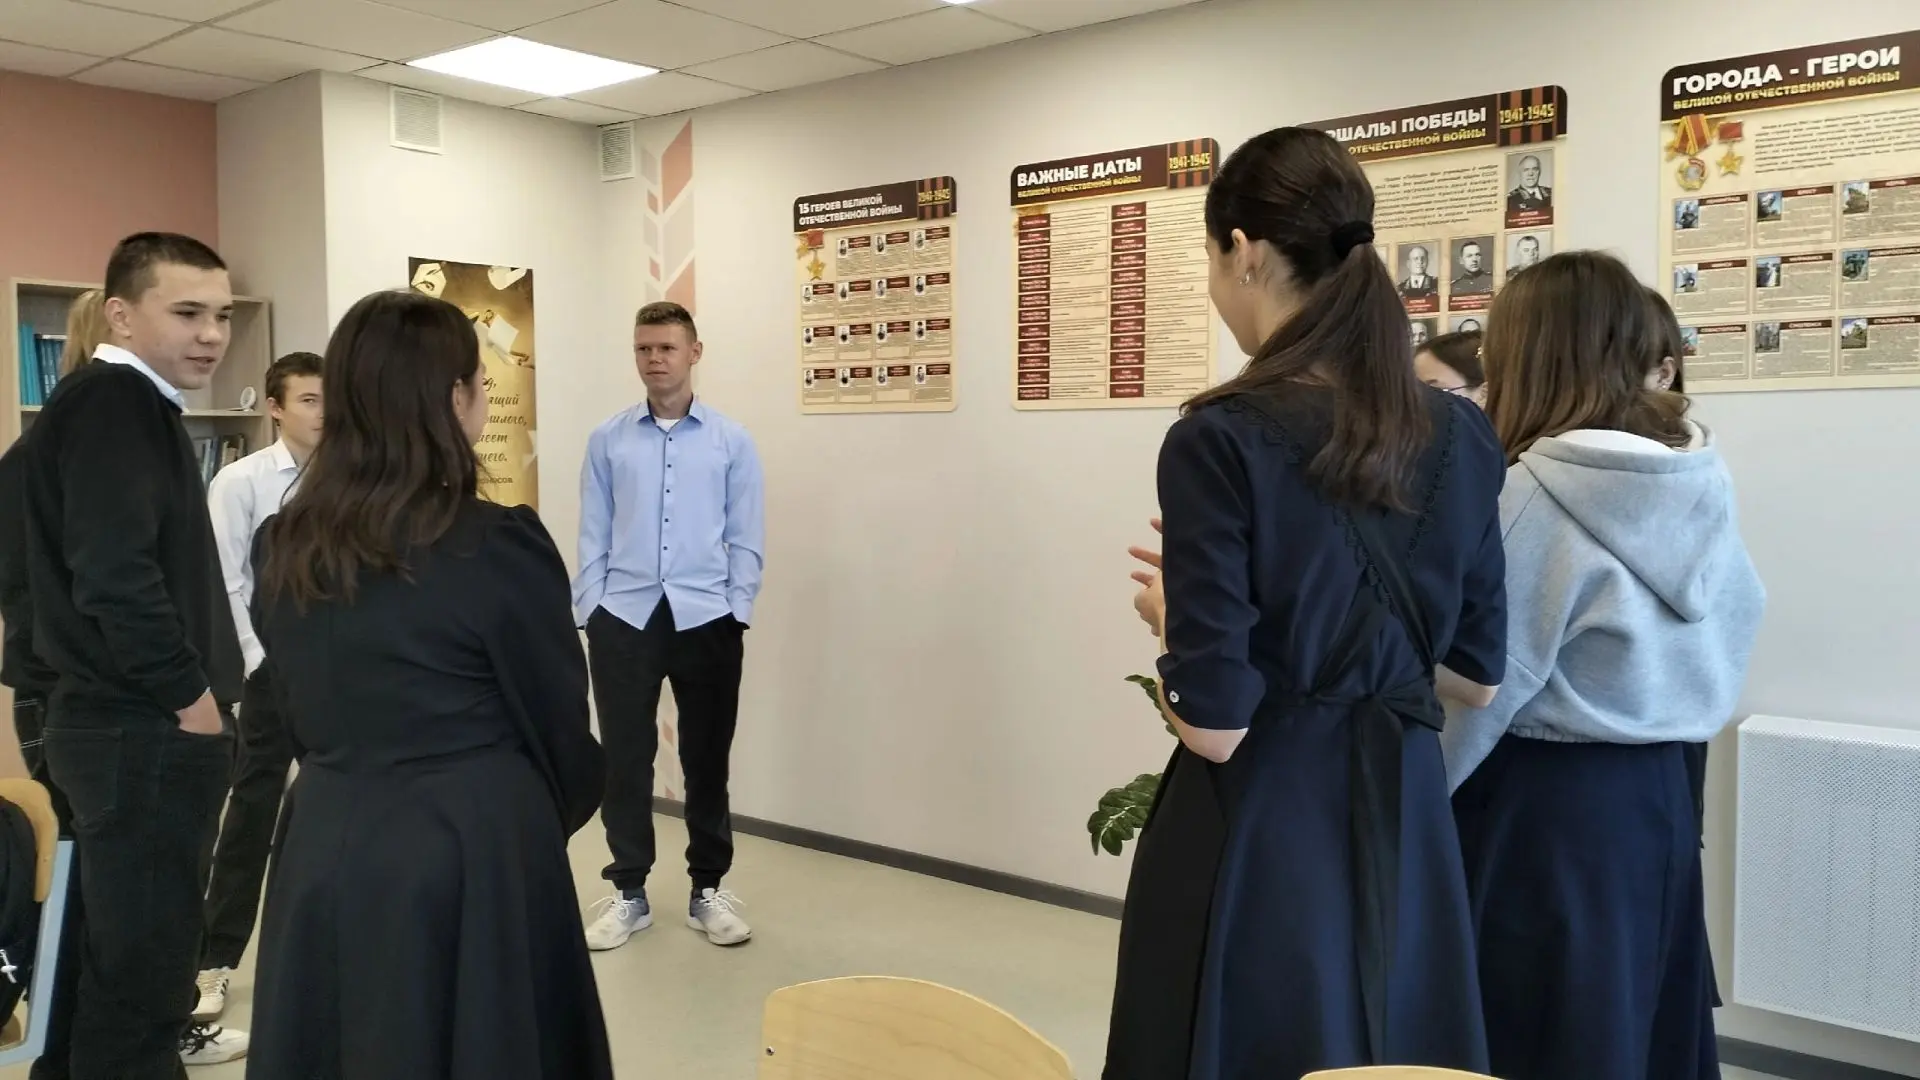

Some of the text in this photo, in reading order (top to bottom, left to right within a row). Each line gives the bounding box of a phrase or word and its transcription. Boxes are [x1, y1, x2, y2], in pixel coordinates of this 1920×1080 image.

[1673, 64, 1783, 95] ГОРОДА
[1807, 46, 1900, 77] ГЕРОИ
[1673, 71, 1900, 110] ВЕЛИКОЙ ОТЕЧЕСТВЕННОЙ ВОЙНЫ
[1325, 107, 1486, 142] РШАЛЫ ПОБЕДЫ
[1499, 103, 1554, 123] 1941-1945
[1348, 128, 1486, 155] ОТЕЧЕСТВЕННОЙ ВОЙНЫ
[1017, 156, 1142, 187] ВАЖНЫЕ ДАТЫ
[1169, 152, 1211, 169] 1941-1945
[1017, 175, 1142, 198] ВЕЛИКОЙ ОТЕЧЕСТВЕННОЙ ВОЙНЫ
[799, 193, 883, 214] 15 ГЕРОЕВ ВЕЛИКОЙ
[799, 204, 903, 225] ОТЕЧЕСТВЕННОЙ ВОЙНЫ
[489, 415, 528, 427] шлого,
